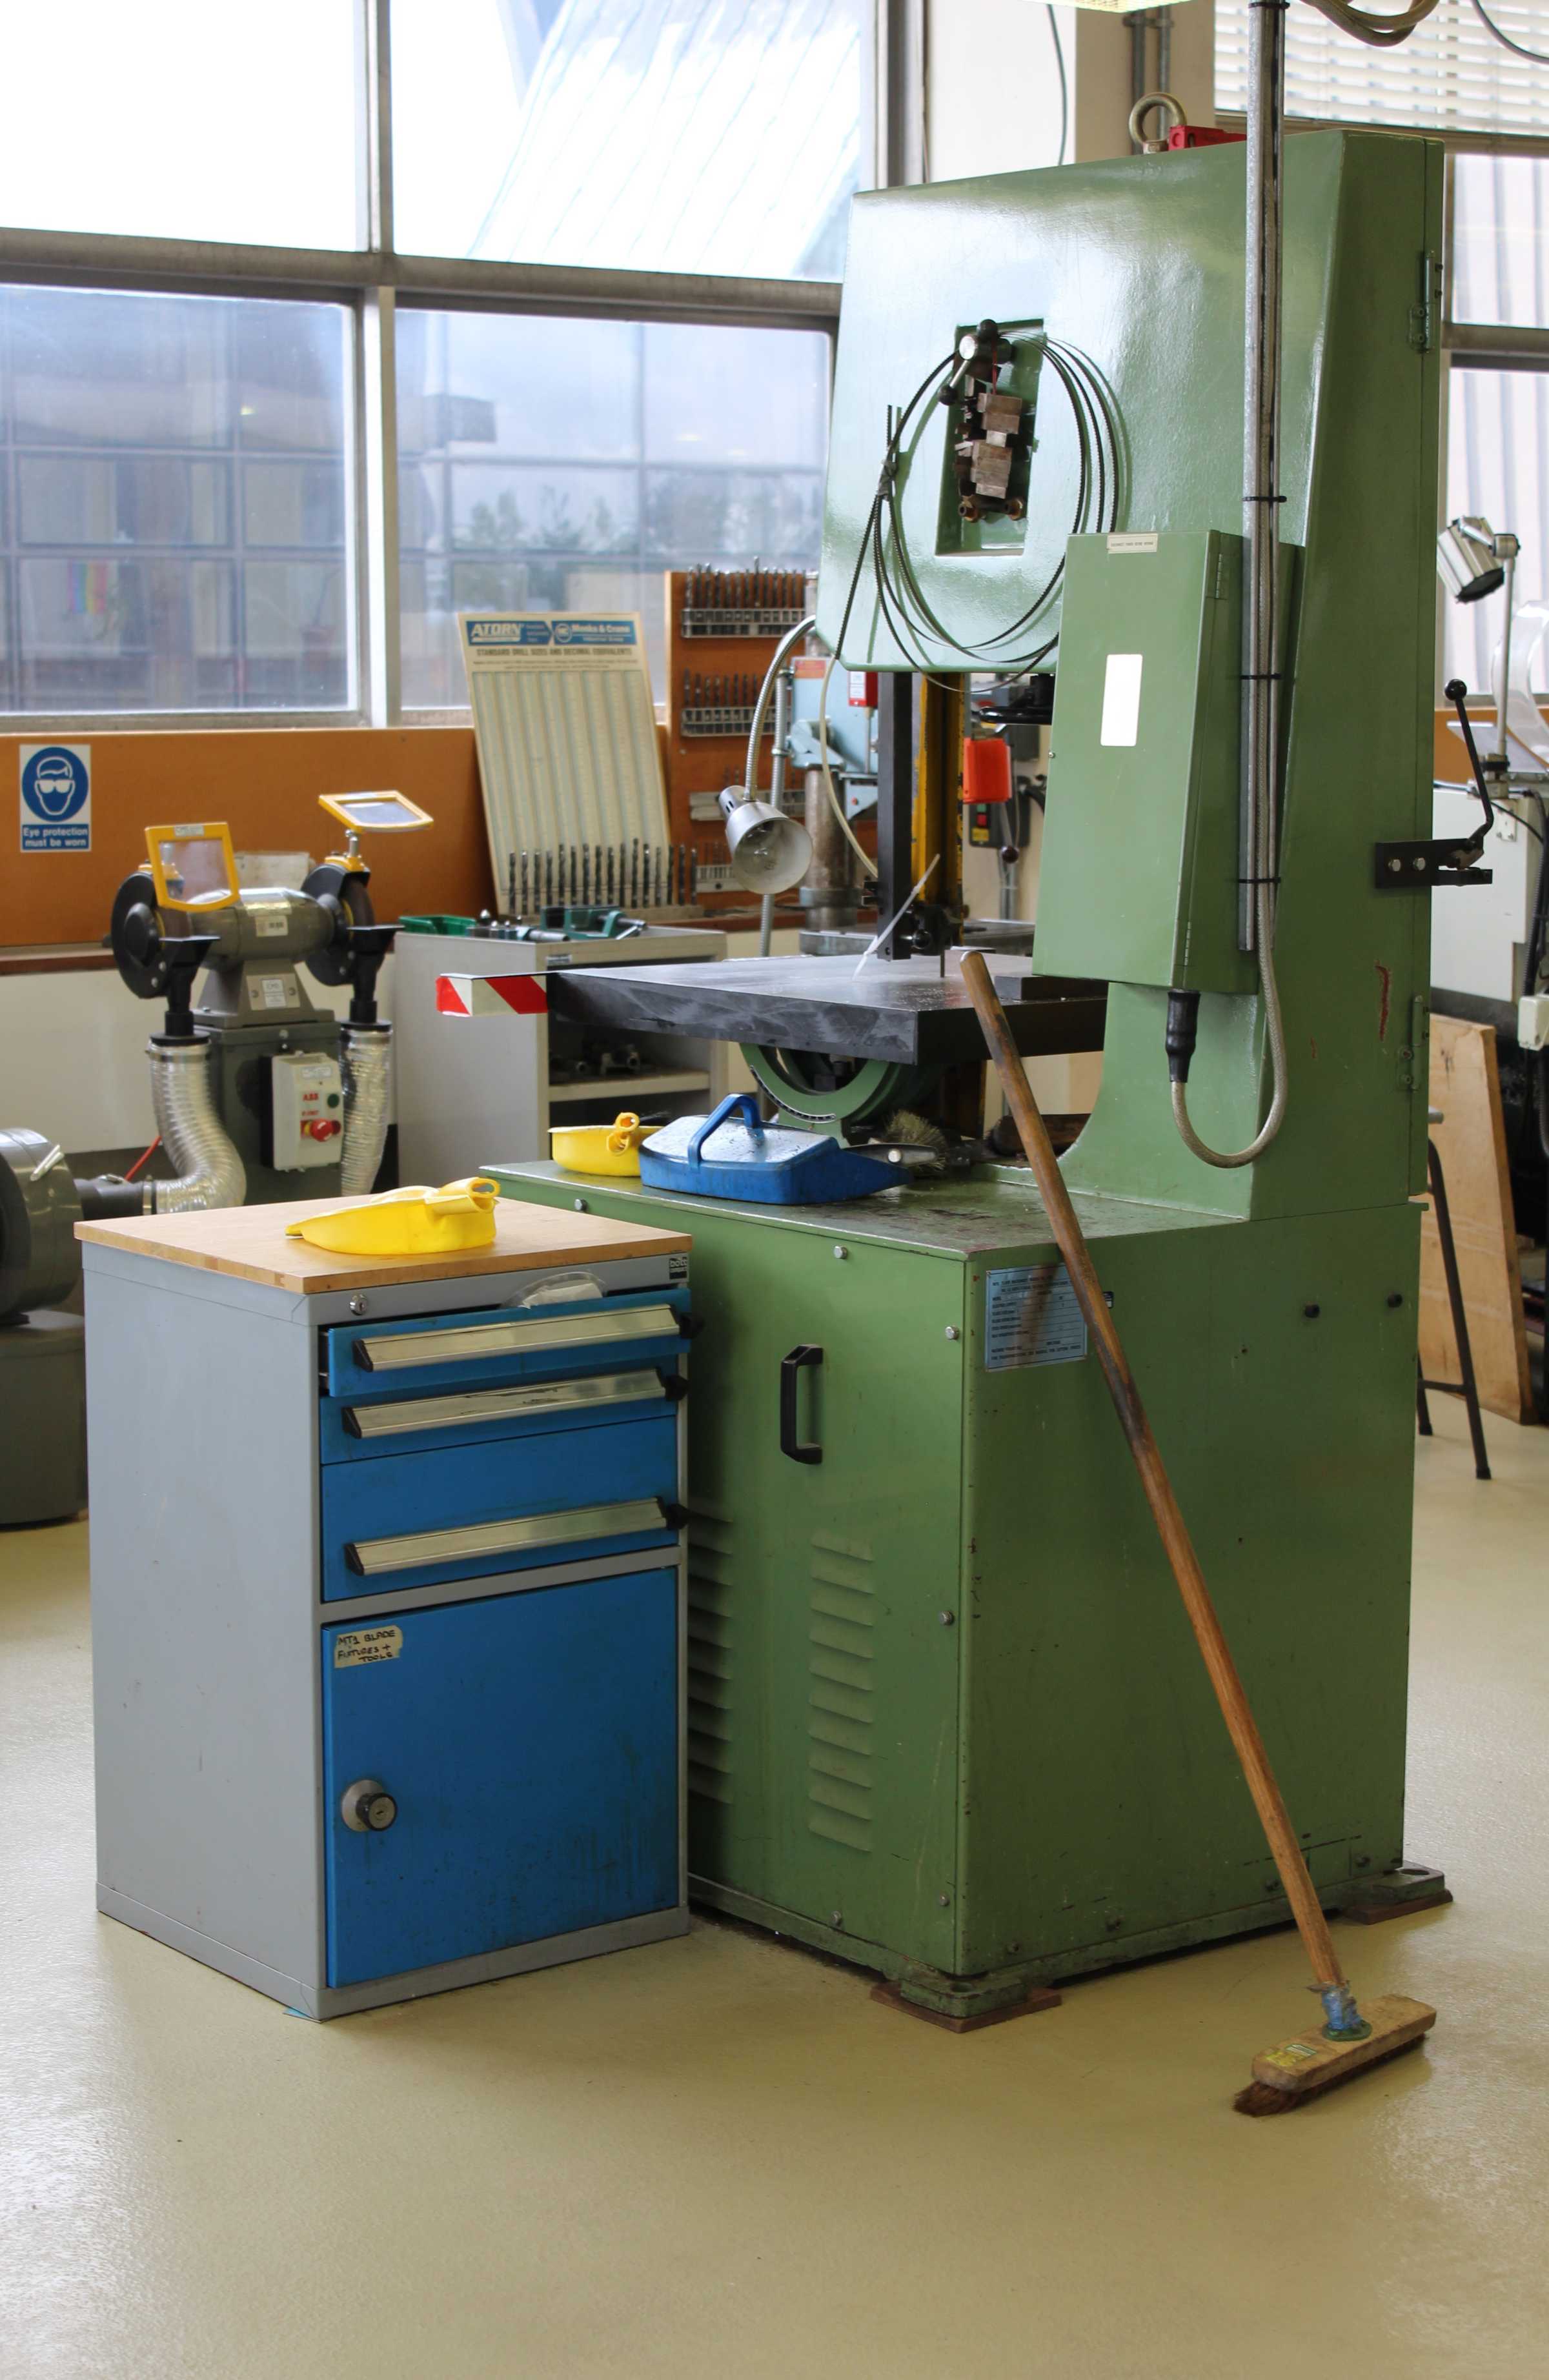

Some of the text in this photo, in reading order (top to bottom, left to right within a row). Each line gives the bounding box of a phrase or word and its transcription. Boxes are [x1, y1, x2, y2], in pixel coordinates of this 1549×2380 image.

[471, 623, 523, 637] ATORN
[23, 827, 88, 838] Eye protection
[25, 838, 47, 847] must
[50, 838, 61, 847] be
[303, 1093, 319, 1102] ABB
[364, 1629, 396, 1642] BLADE
[358, 1651, 393, 1662] TOOLS
